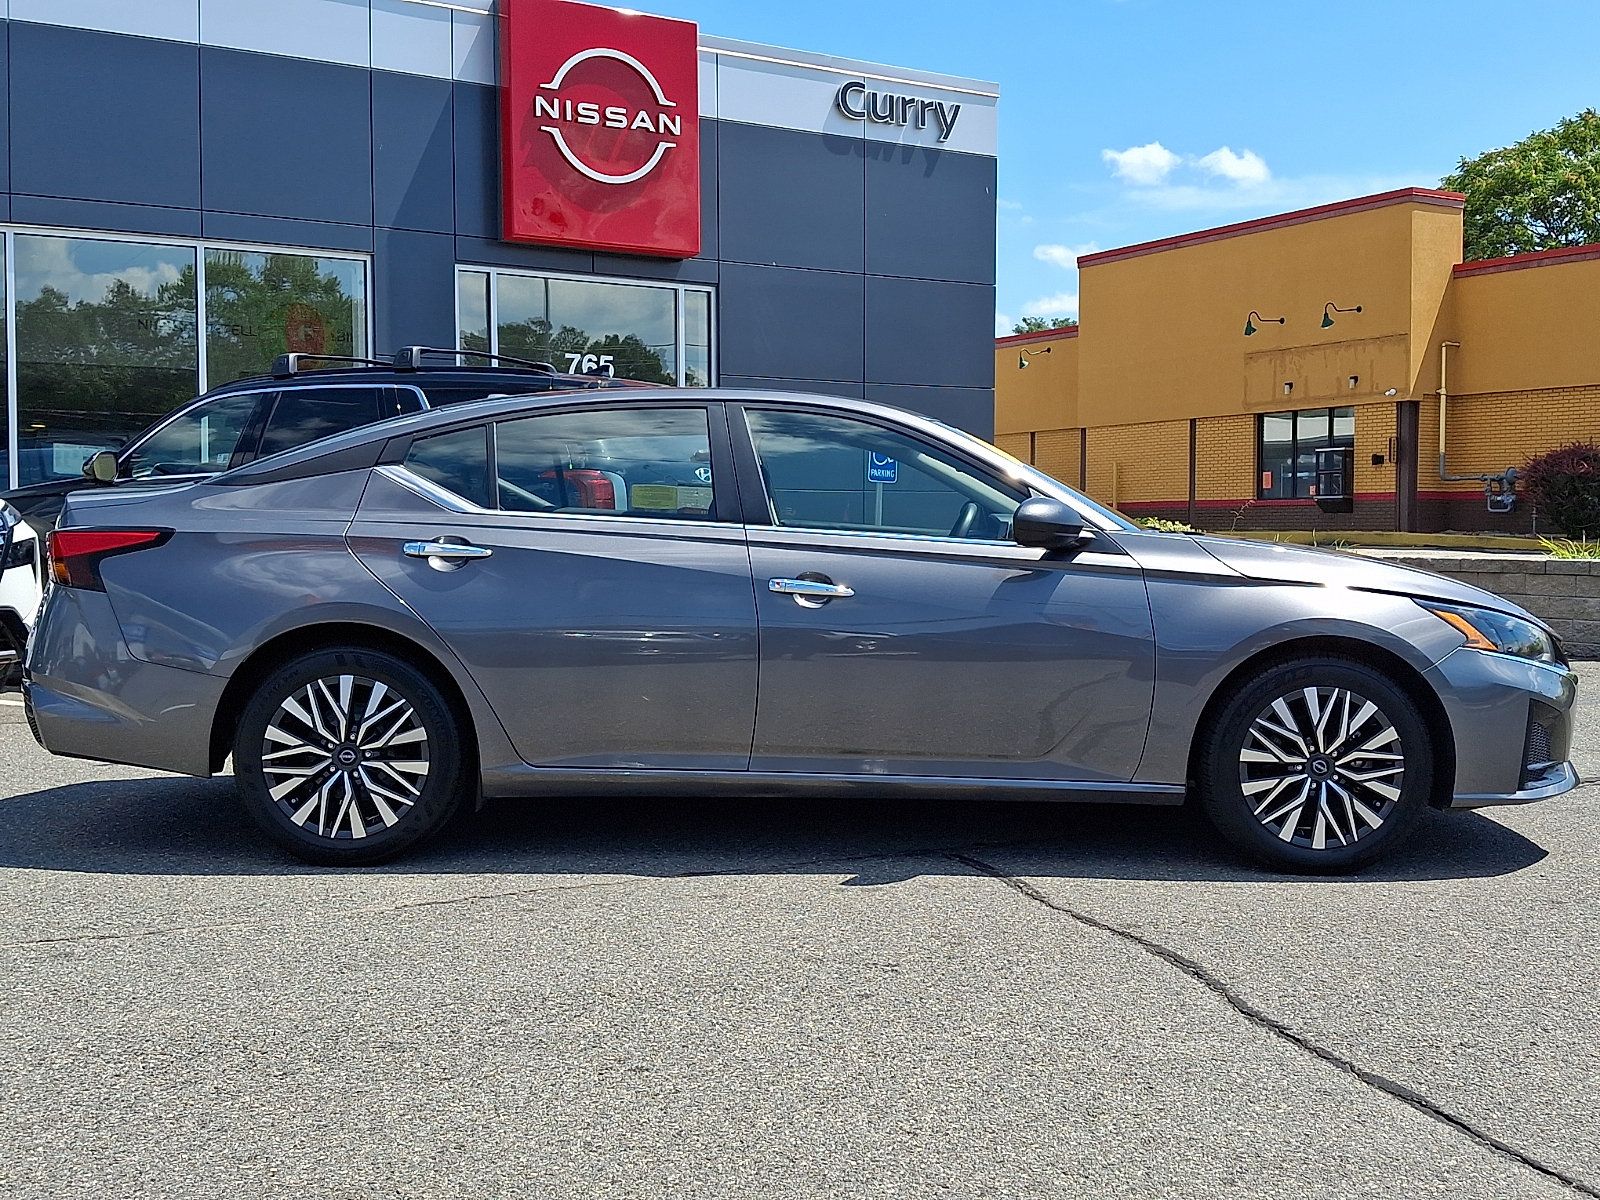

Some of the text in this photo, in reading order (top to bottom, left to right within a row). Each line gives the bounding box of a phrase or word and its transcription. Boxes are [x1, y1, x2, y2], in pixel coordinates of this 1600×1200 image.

[535, 95, 681, 136] NISSAN
[837, 80, 961, 142] Curry
[564, 352, 615, 379] 765
[870, 468, 895, 478] PARKING
